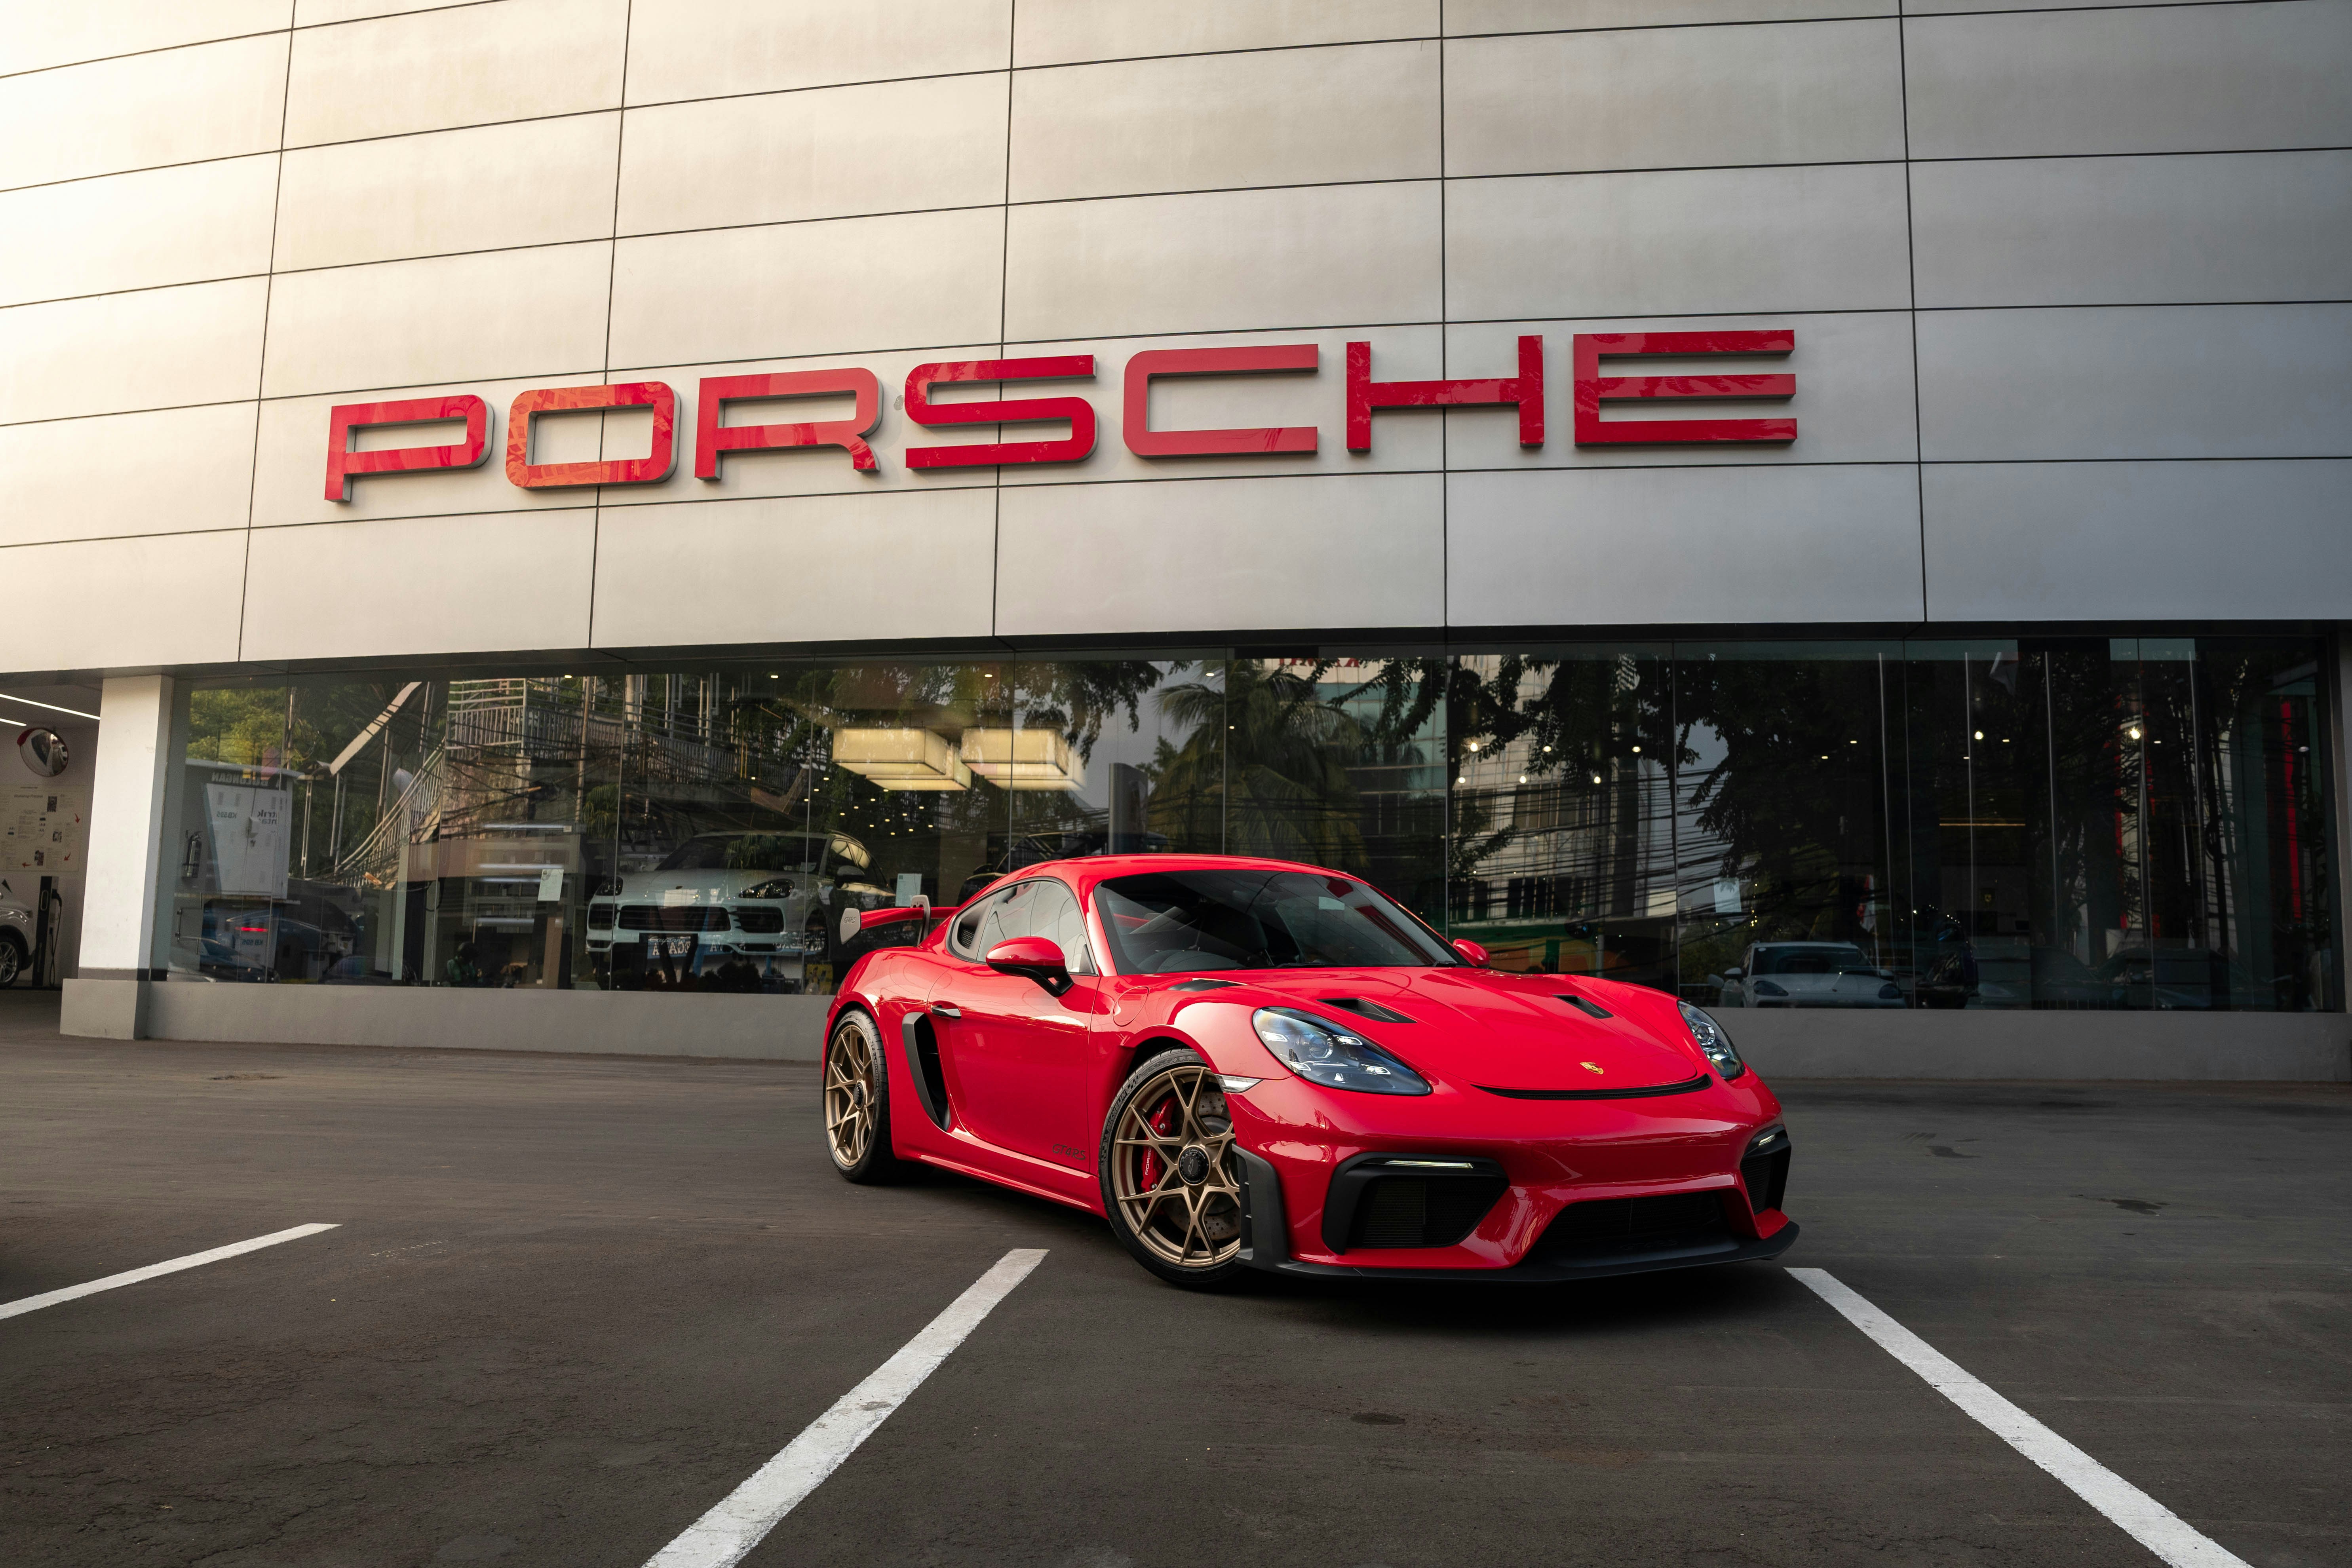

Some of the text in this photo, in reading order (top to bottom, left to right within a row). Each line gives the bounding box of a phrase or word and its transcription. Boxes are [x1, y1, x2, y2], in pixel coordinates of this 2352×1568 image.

[324, 330, 1797, 502] PORSCHE
[1107, 1090, 1128, 1131] MICHELIN
[1052, 1143, 1086, 1160] GT4RS
[1187, 1157, 1194, 1175] RS
